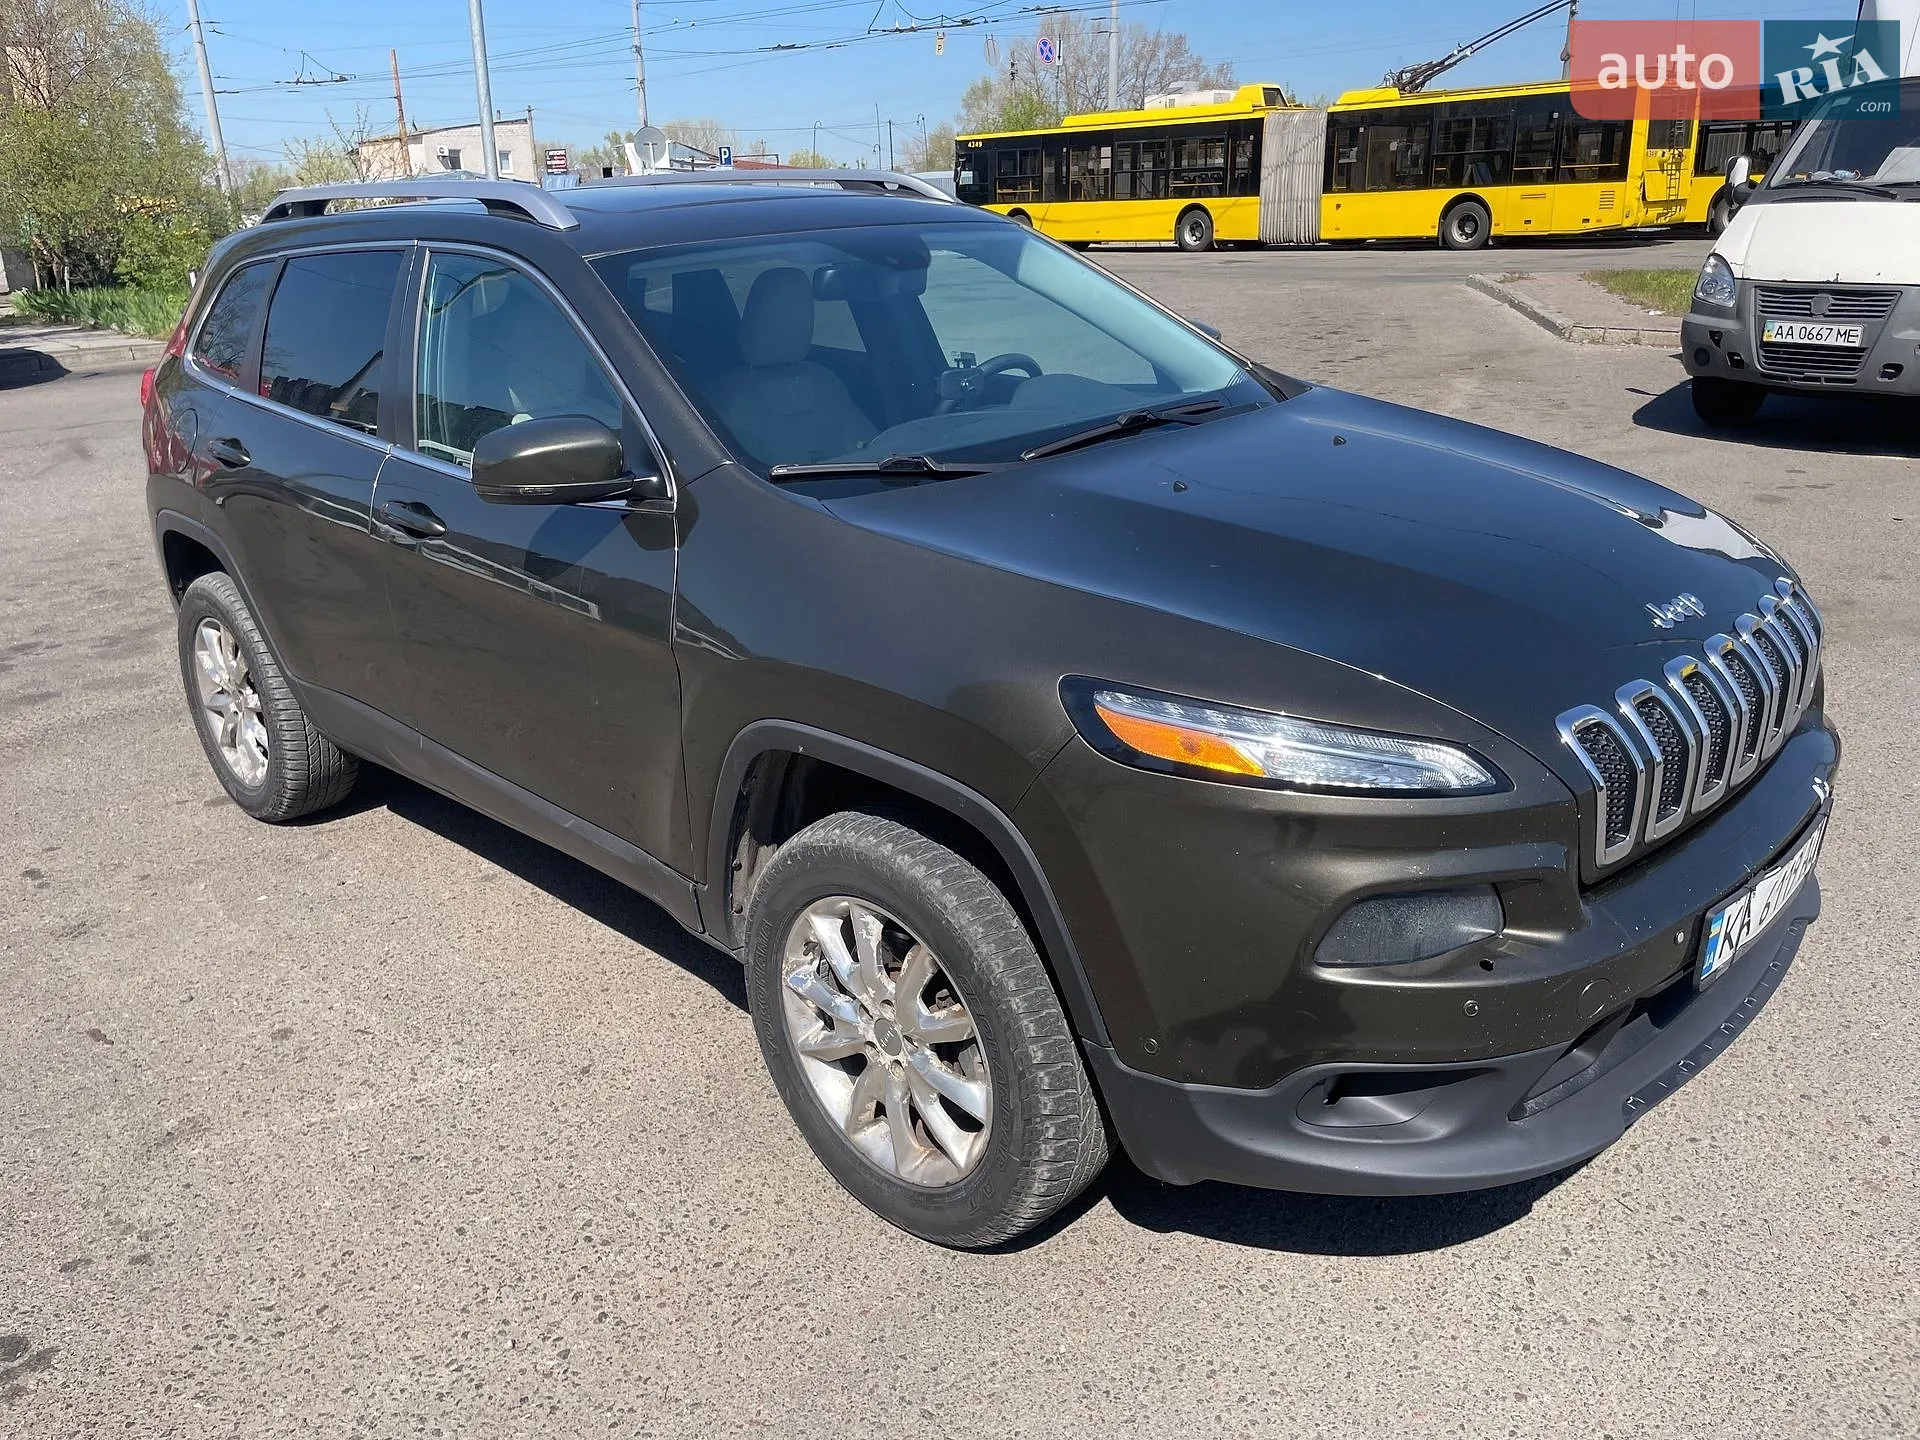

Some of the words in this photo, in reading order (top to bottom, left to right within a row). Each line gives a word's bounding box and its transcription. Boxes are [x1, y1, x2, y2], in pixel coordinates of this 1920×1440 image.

[721, 147, 729, 164] P
[1774, 325, 1794, 340] AA
[1798, 326, 1833, 342] 0667
[1835, 328, 1859, 344] ME
[1644, 592, 1707, 629] Jeep
